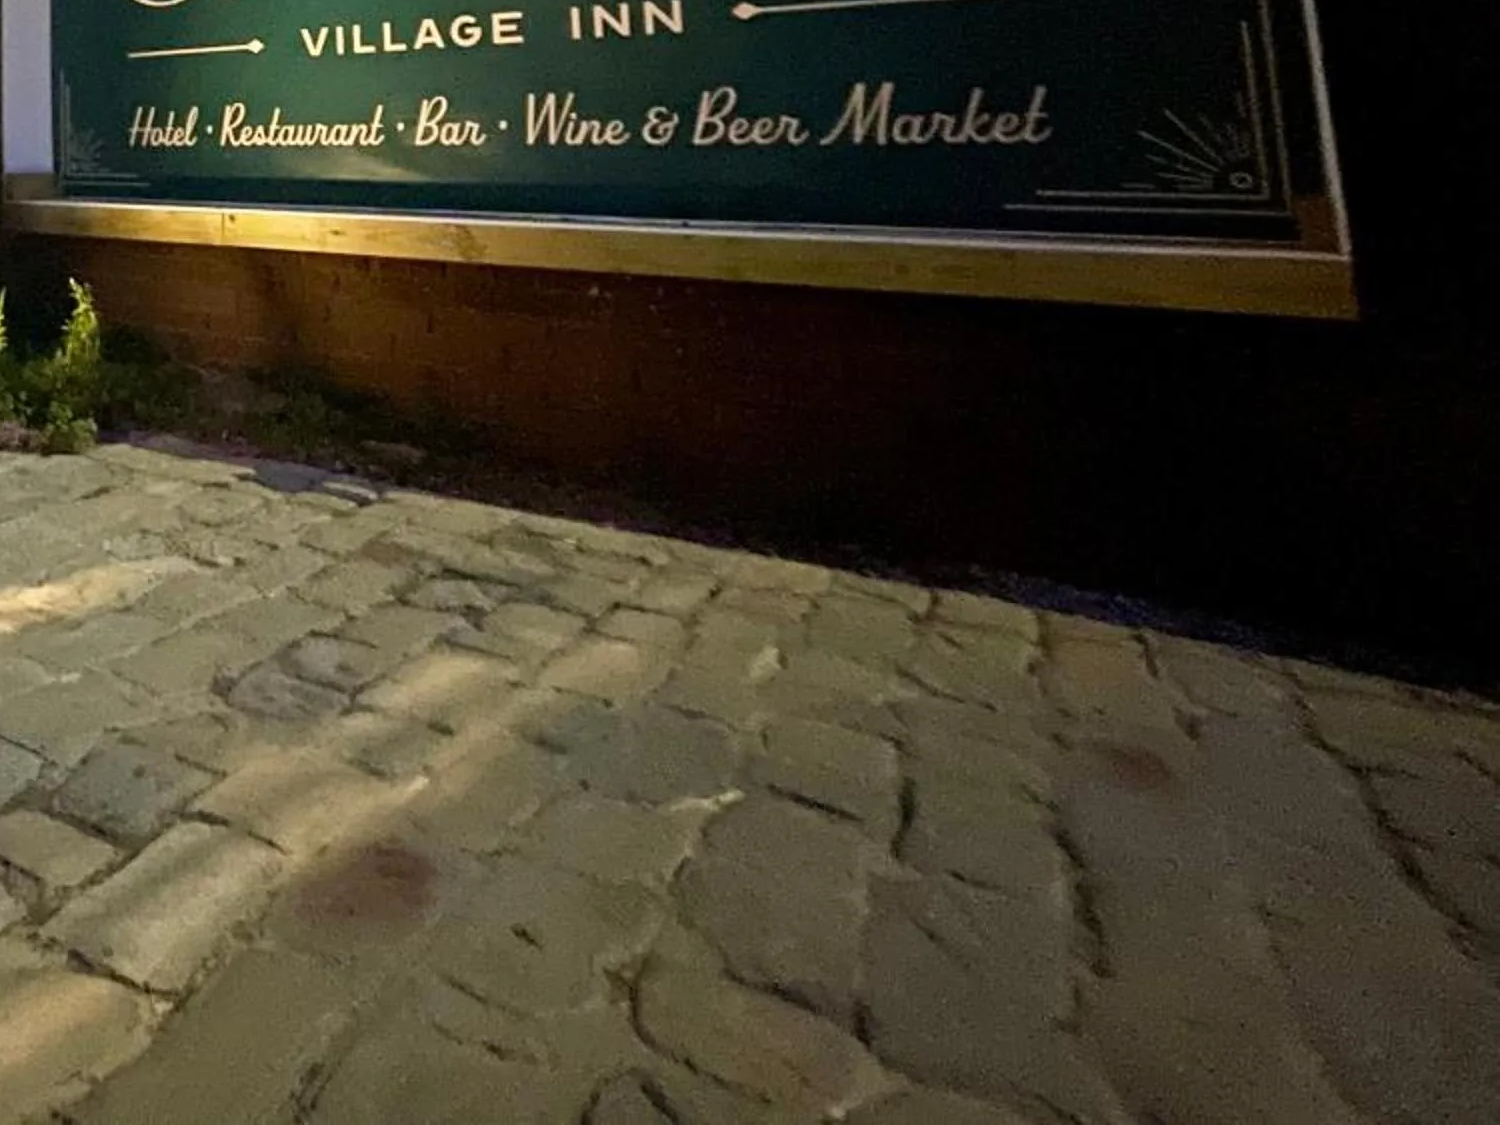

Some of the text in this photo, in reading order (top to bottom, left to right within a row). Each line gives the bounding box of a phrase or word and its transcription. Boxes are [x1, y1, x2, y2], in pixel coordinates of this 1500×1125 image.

[300, 11, 525, 57] VILLAGE
[127, 81, 1054, 149] Hotel Restaurant Bar Wine & Beer Market
